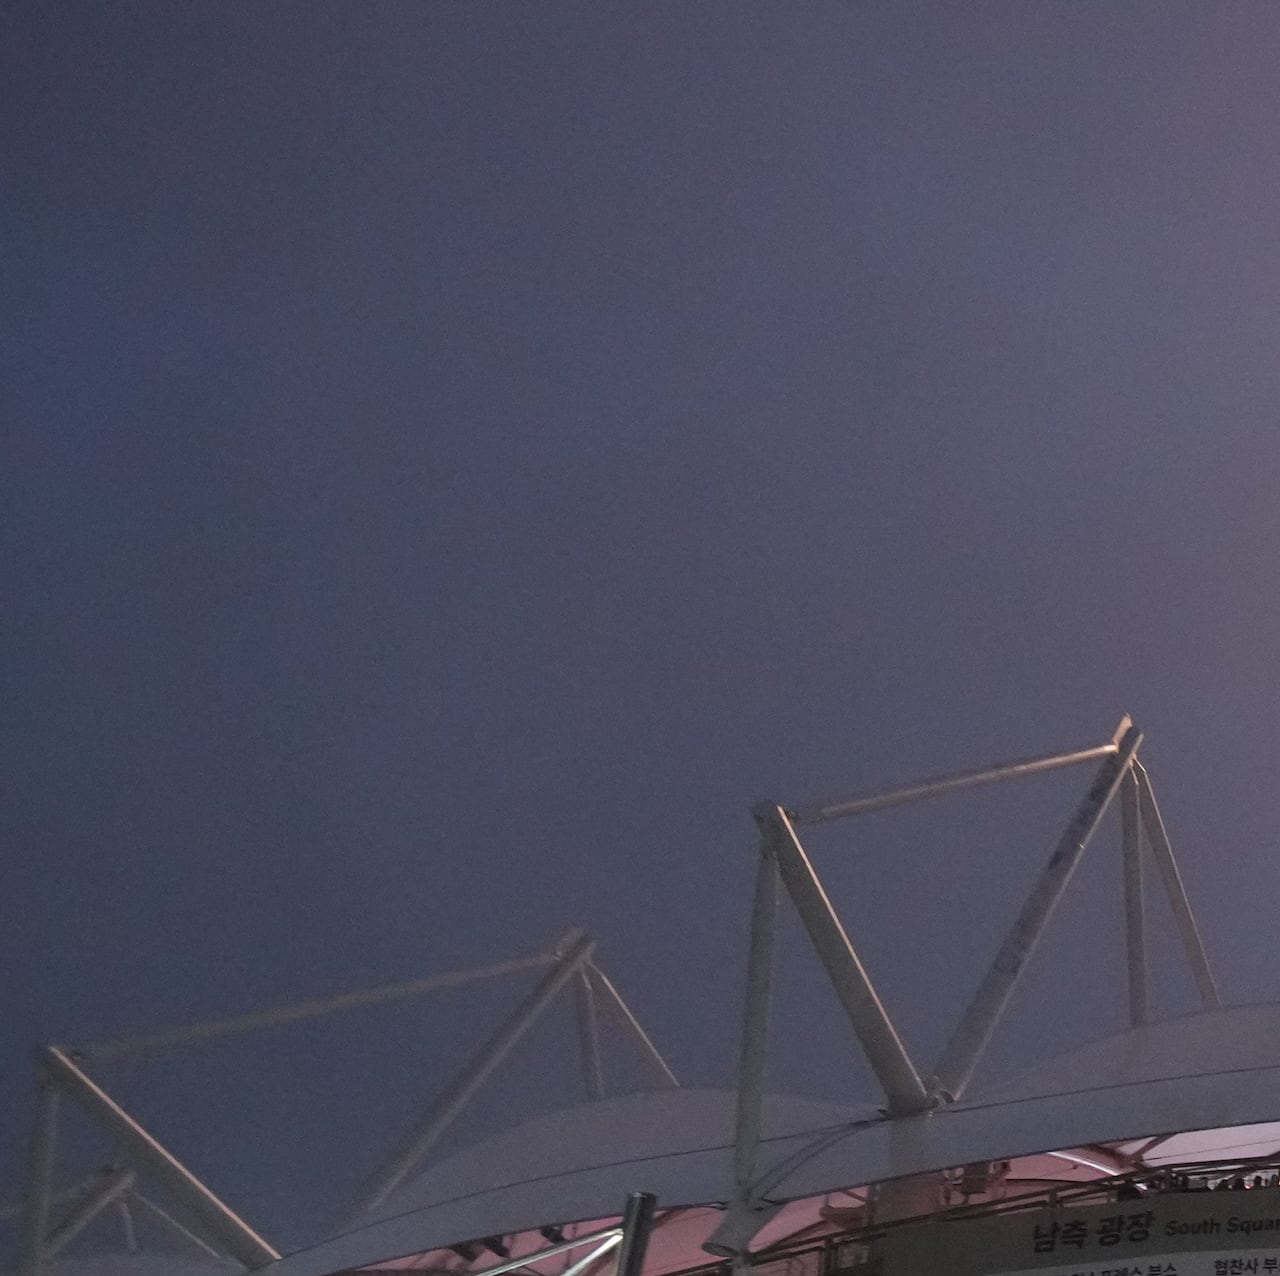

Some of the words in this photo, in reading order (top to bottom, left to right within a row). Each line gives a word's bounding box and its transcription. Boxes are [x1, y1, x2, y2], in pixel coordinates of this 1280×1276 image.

[1033, 1219, 1088, 1252] 남측
[1096, 1211, 1155, 1246] 광장
[1166, 1218, 1221, 1237] South
[1214, 1258, 1258, 1276] 협찬사
